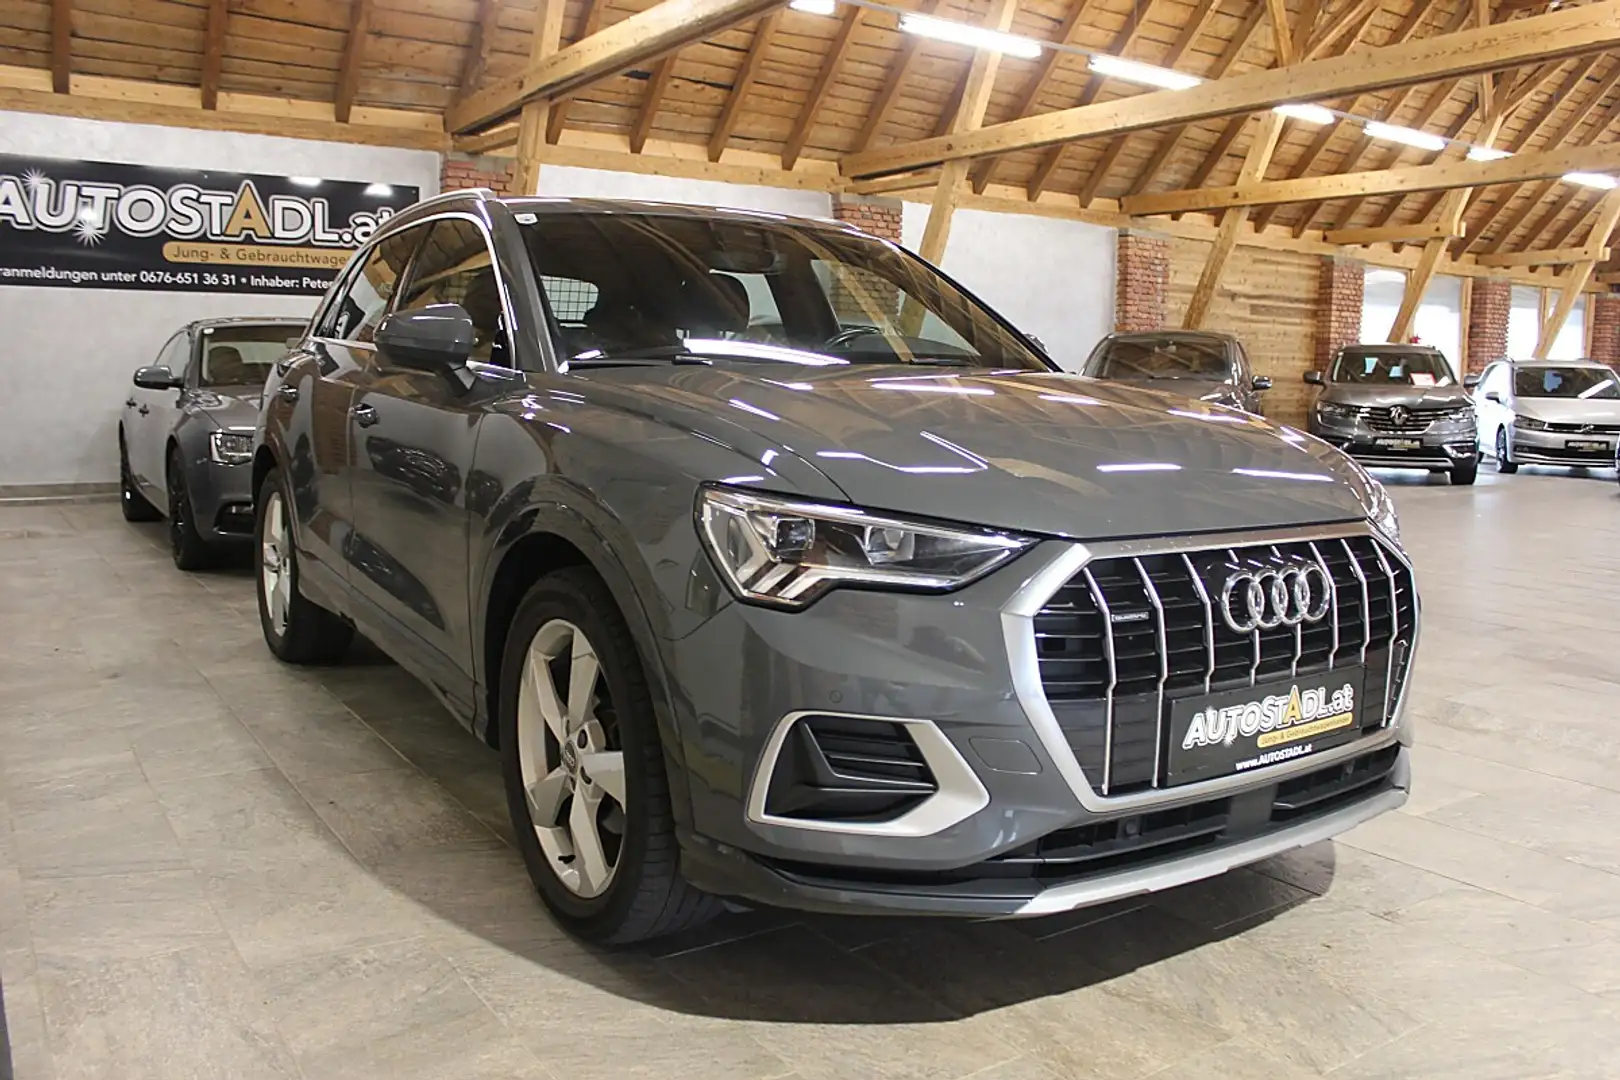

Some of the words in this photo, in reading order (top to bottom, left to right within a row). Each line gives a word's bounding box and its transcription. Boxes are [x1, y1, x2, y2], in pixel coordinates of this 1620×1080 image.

[172, 246, 214, 262] Jung-
[220, 248, 231, 260] &
[236, 249, 350, 267] Gebrauchtwage
[101, 272, 137, 283] unter
[140, 271, 199, 285] 0676-651
[203, 273, 219, 285] 36
[222, 273, 236, 286] 31
[250, 275, 300, 288] Inhaber:
[1182, 684, 1354, 749] AUTOSTADL.at
[1235, 743, 1313, 771] www.AUTOSTADL.at
